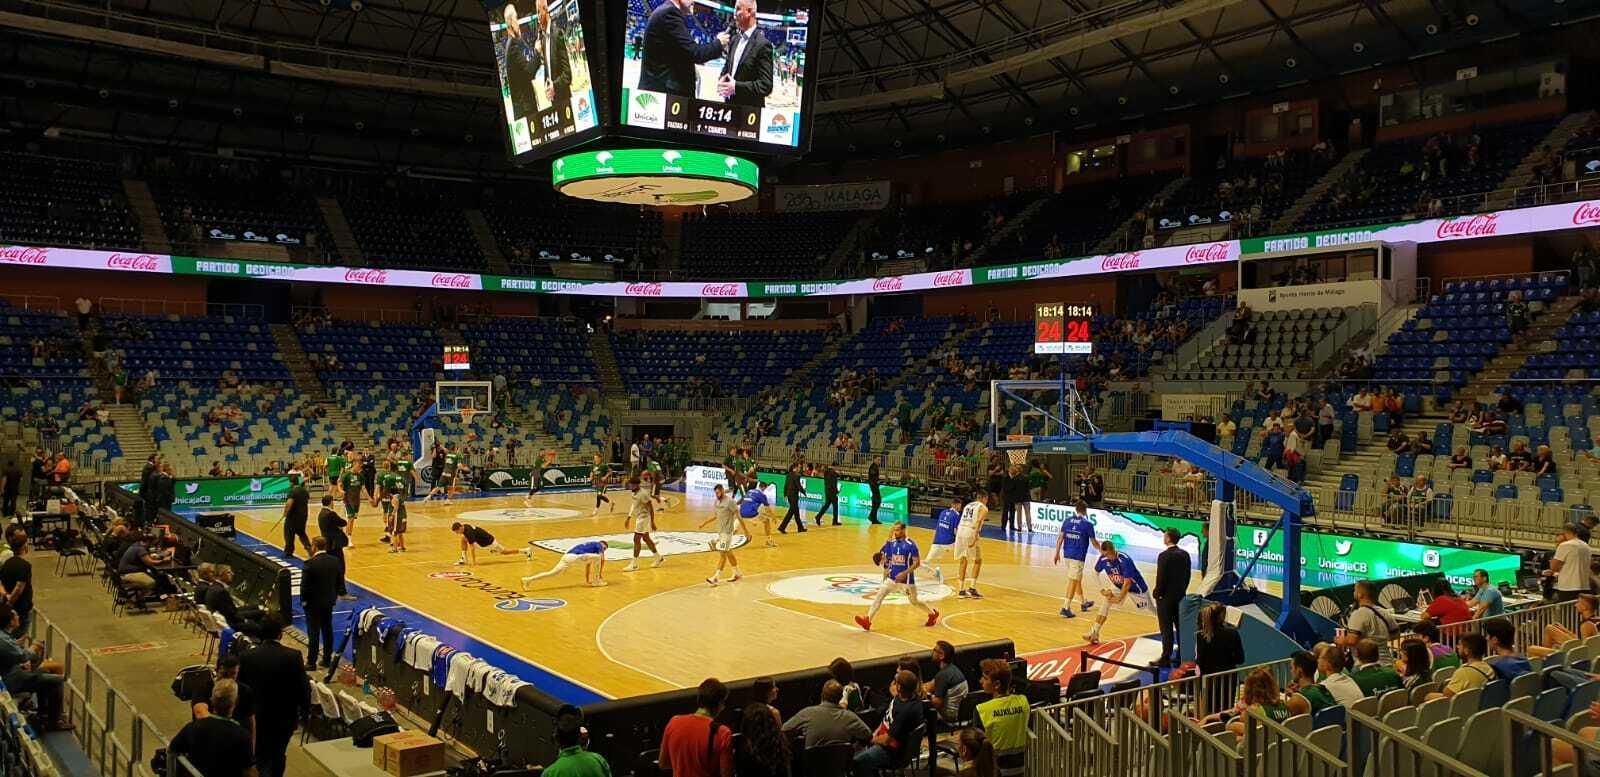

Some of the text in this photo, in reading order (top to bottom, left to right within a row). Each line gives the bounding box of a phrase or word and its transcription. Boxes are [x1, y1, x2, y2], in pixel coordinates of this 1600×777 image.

[671, 102, 680, 115] 0
[699, 105, 732, 123] 18:14
[747, 113, 757, 126] 0
[1264, 237, 1309, 253] PARTIDO
[196, 260, 240, 273] PARTIDO
[501, 278, 536, 290] PARTIDO
[1037, 305, 1064, 317] 18:14
[1067, 305, 1092, 317] 18:14
[1038, 319, 1062, 342] 24
[1067, 320, 1089, 342] 24
[963, 507, 974, 519] 34
[1318, 556, 1368, 573] UnicajaCB
[993, 705, 1025, 718] AUXILIAR
